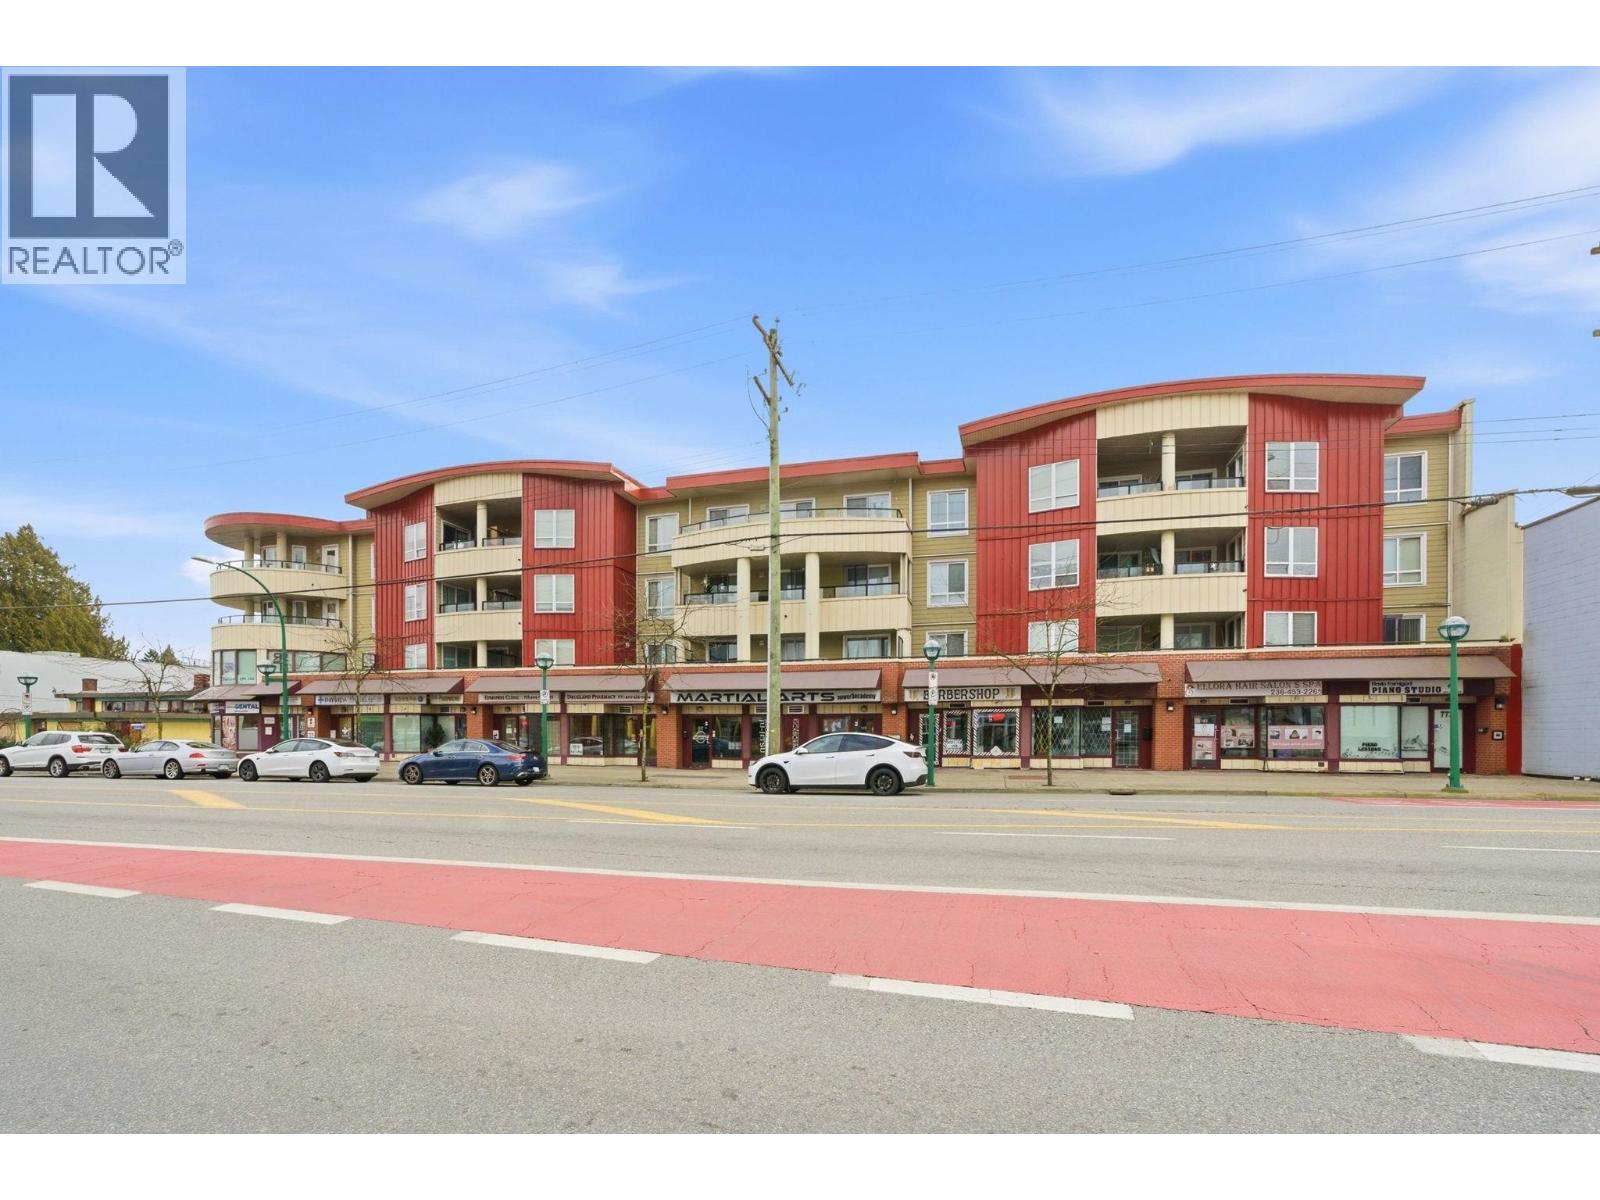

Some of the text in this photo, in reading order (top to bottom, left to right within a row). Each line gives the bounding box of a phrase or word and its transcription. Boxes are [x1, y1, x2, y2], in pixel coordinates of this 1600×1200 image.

[1235, 681, 1258, 690] HAIR
[1260, 680, 1292, 689] SALON
[677, 692, 767, 702] MARTIAL
[780, 692, 835, 702] ARTS
[923, 688, 1000, 700] BRBERSHOP
